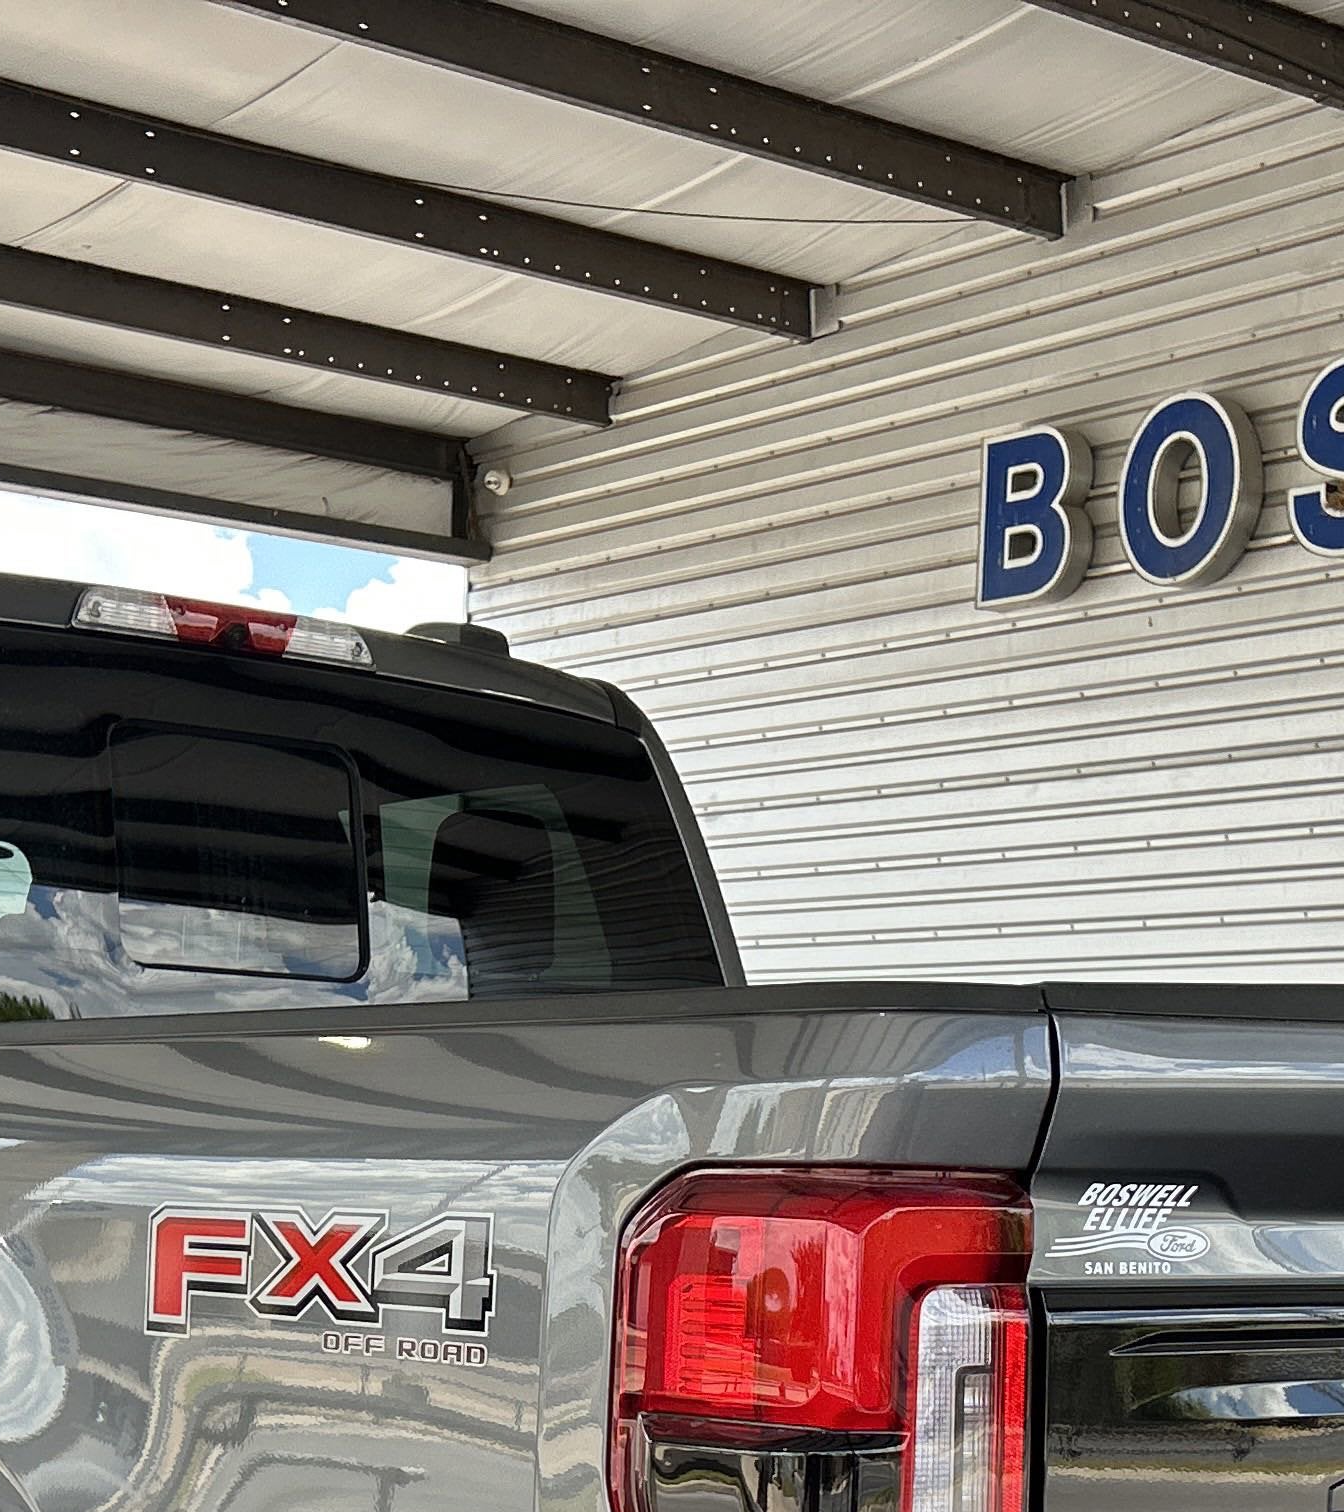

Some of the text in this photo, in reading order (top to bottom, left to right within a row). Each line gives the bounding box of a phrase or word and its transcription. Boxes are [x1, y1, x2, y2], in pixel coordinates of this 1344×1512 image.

[1078, 1182, 1199, 1208] BOSWELL
[1083, 1208, 1172, 1231] ELLIFF
[1159, 1233, 1197, 1254] Ford
[144, 1202, 497, 1337] FX4
[1084, 1261, 1172, 1275] SAN BENITO
[322, 1331, 488, 1366] OFF ROAD
